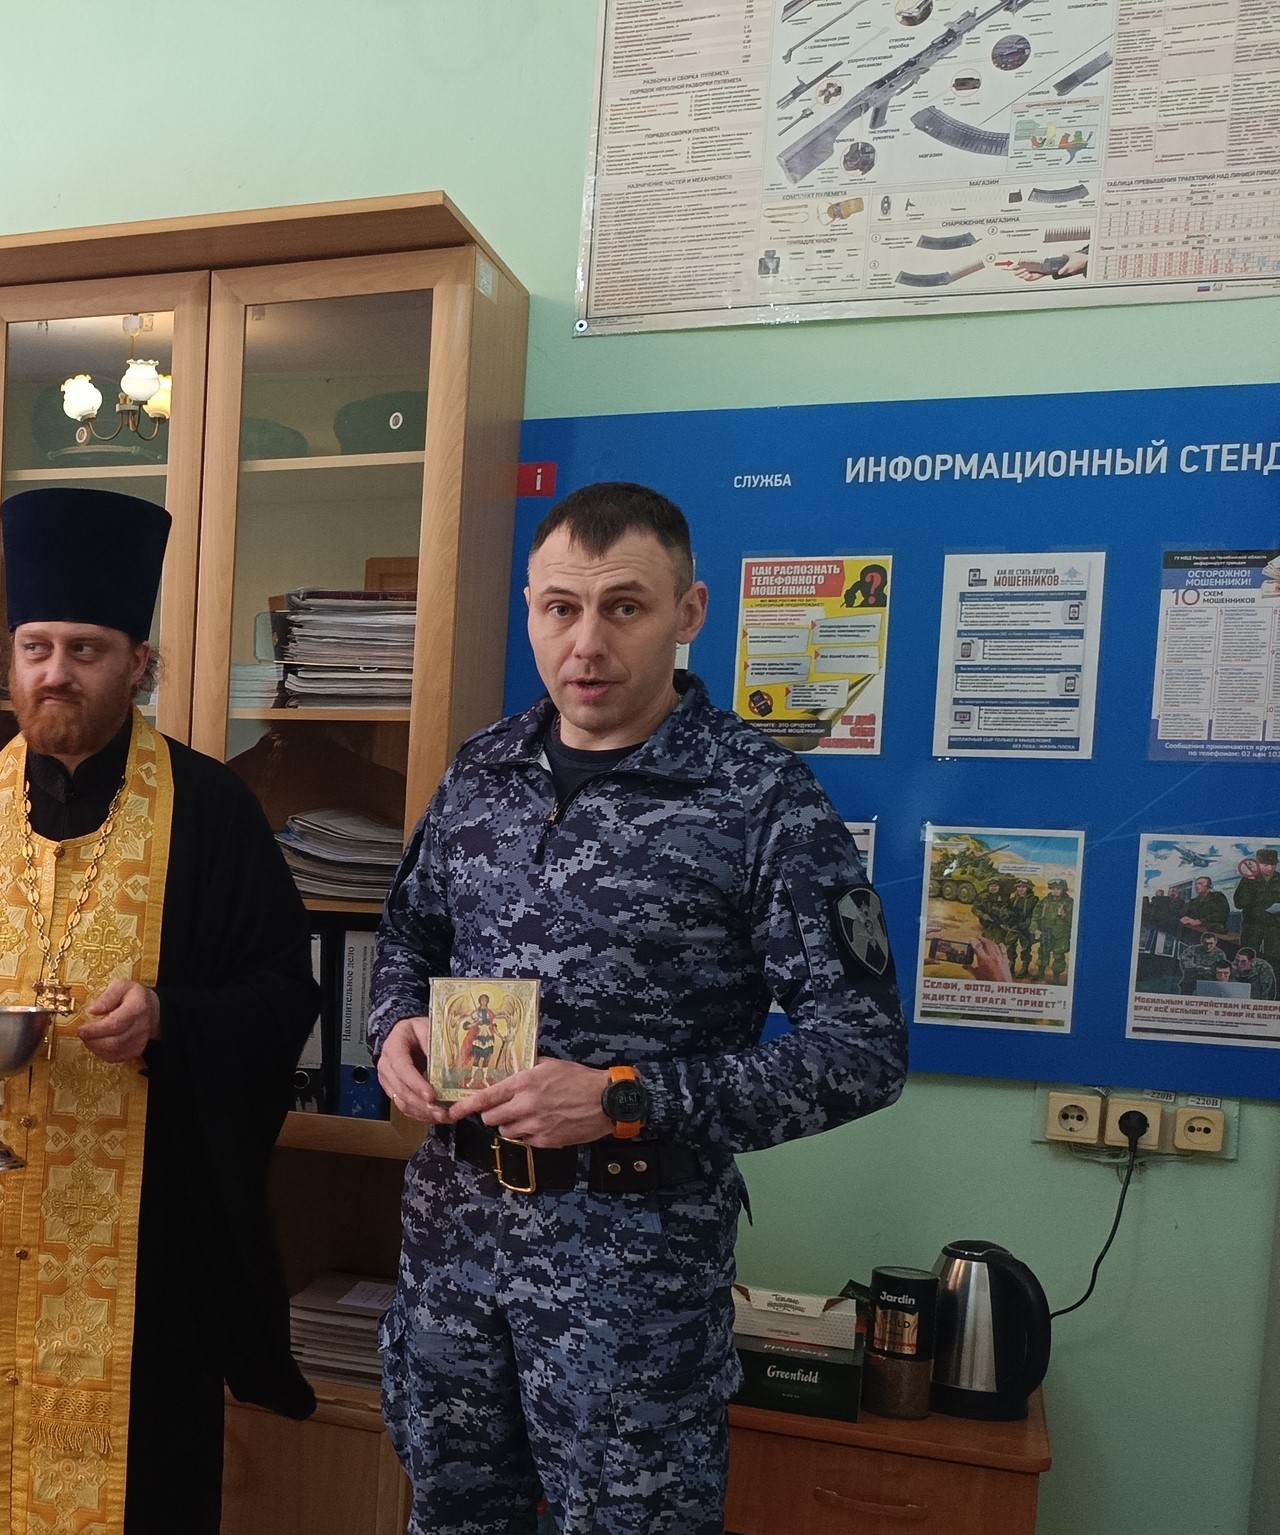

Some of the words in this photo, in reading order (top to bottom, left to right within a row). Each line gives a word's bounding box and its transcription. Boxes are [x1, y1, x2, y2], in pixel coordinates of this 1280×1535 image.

[845, 439, 1168, 484] ИНФОРМАЦИОННЫЙ
[1179, 442, 1280, 476] СТЕНД
[733, 473, 792, 489] СЛУЖБА
[752, 566, 771, 576] КАК
[774, 564, 840, 575] РАСПОЗНАТЬ
[1188, 570, 1251, 578] ОСТОРОЖНО!
[751, 575, 825, 585] ТЕЛЕФОННОГО
[994, 575, 1059, 587] МОШЕННИКОВ
[1185, 578, 1251, 586] МОШЕННИКИ!
[750, 586, 816, 595] МОШЕННИКА
[1172, 588, 1200, 606] 10
[347, 946, 356, 969] дело
[998, 985, 1048, 996] ИНТЕРНЕТ
[922, 993, 956, 1002] ЖДИТЕ
[960, 995, 972, 1003] ОТ
[975, 996, 1007, 1005] ВРАГА
[342, 970, 355, 1042] Накопительное
[880, 1291, 916, 1305] Jardin
[766, 1364, 819, 1384] Greenfield
